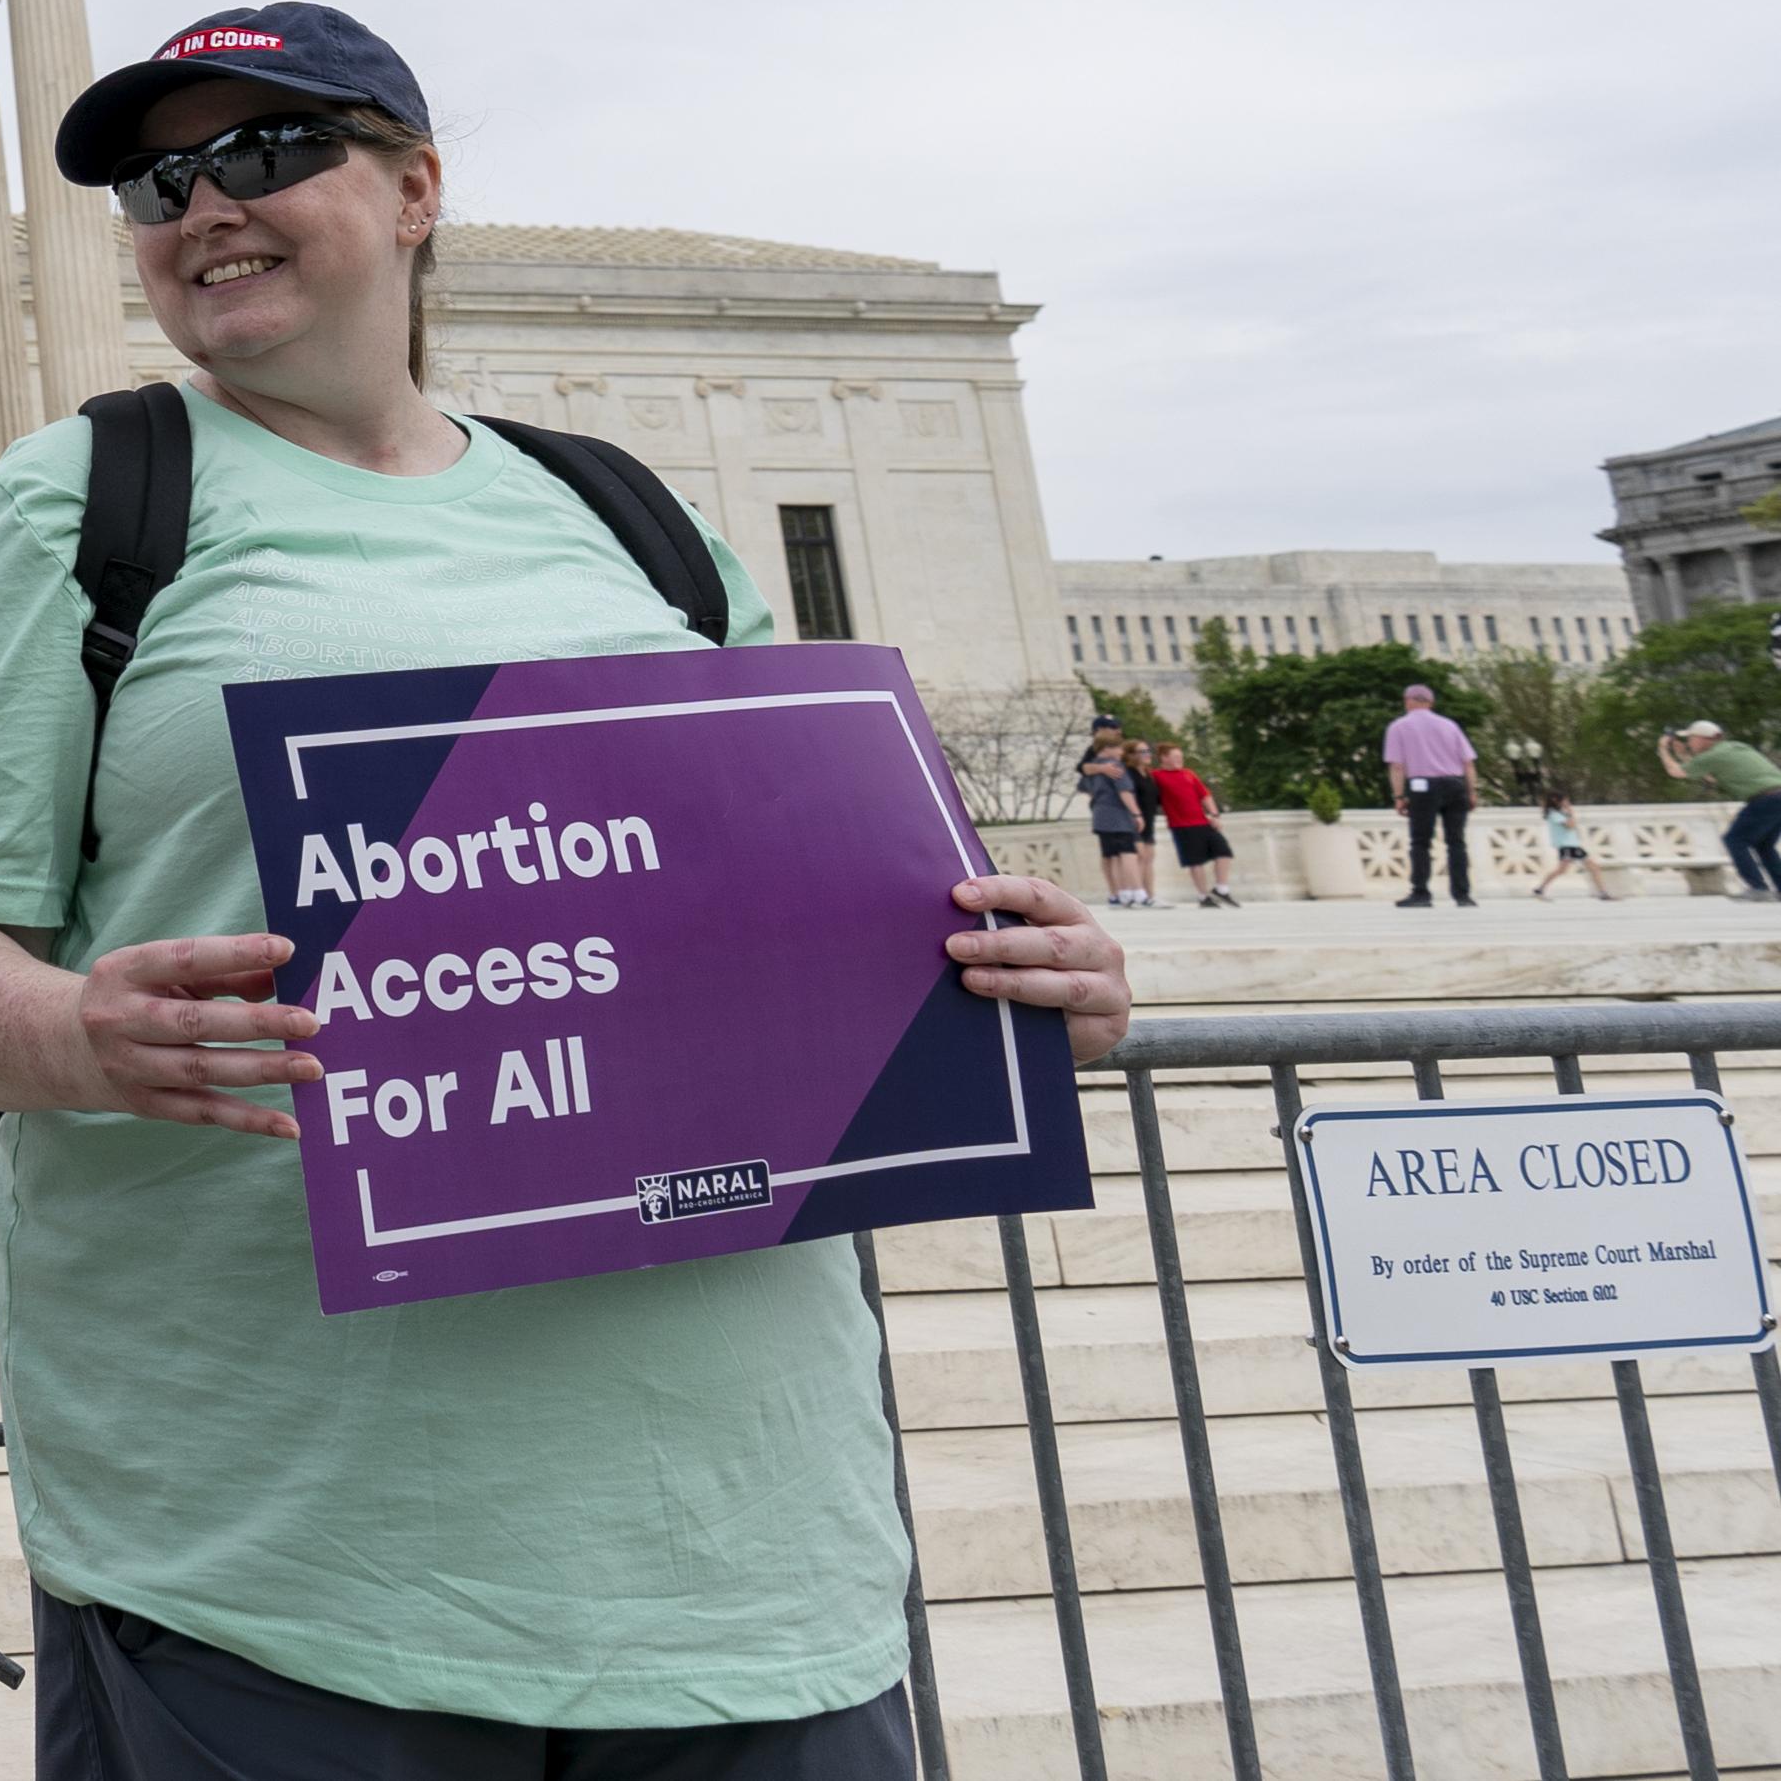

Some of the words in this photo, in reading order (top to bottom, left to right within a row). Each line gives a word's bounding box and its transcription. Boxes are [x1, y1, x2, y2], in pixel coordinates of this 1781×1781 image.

[184, 35, 204, 53] IN
[210, 31, 280, 48] COURT
[227, 608, 436, 646] ABORTION
[296, 801, 660, 907] Abortion
[316, 935, 619, 1025] Access
[325, 1067, 458, 1146] For
[489, 1036, 592, 1125] All
[676, 1169, 762, 1200] NARAL
[1366, 1147, 1502, 1197] AREA
[1519, 1138, 1692, 1191] CLOSED
[678, 1197, 726, 1209] PRO-CHOICE
[729, 1192, 763, 1202] AMERICA
[1370, 1255, 1394, 1279] By
[1403, 1253, 1450, 1276] order
[1458, 1251, 1477, 1272] of
[1485, 1249, 1513, 1271] the
[1520, 1247, 1589, 1273] Supreme
[1595, 1244, 1642, 1265] Court
[1649, 1240, 1717, 1263] Marshal
[1490, 1290, 1506, 1307] 40
[1510, 1289, 1539, 1305] USC
[1543, 1286, 1588, 1305] Section
[1592, 1284, 1618, 1301] 6102
